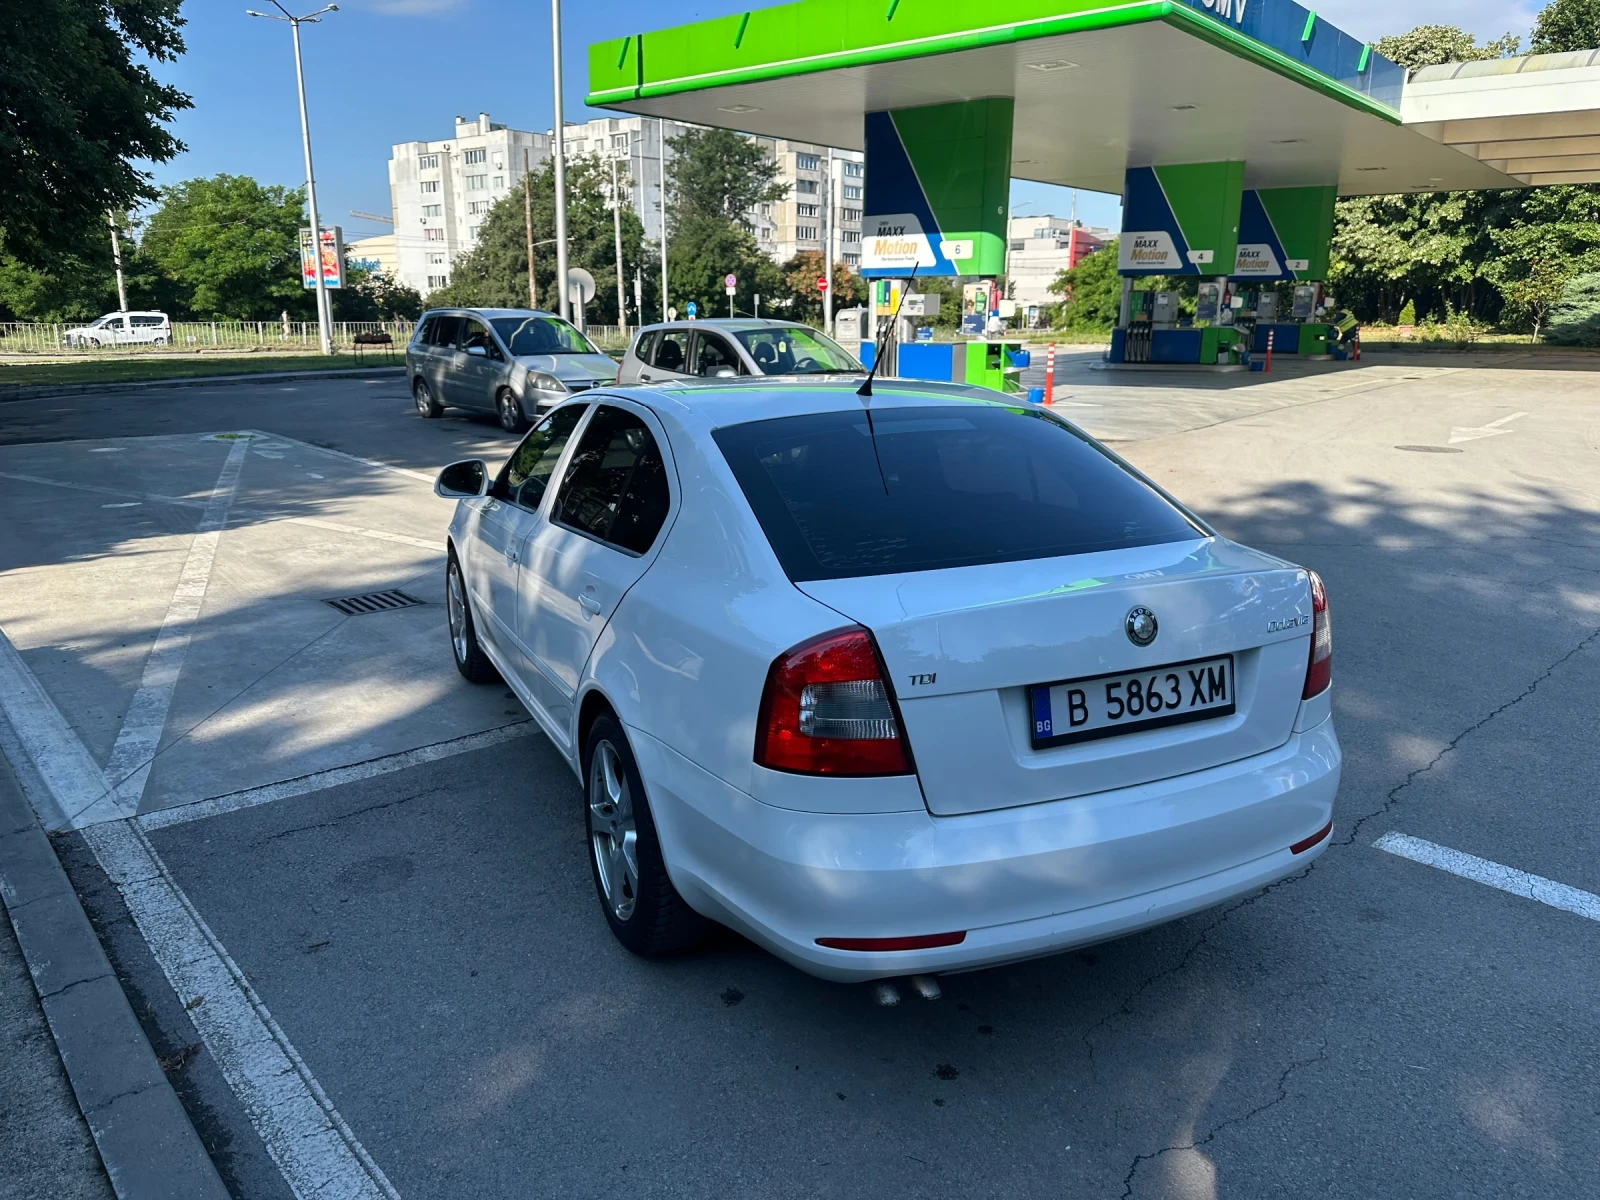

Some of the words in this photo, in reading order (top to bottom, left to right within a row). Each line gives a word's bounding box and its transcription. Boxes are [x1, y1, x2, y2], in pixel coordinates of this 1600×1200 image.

[997, 205, 1003, 215] 6
[877, 226, 906, 237] MAXX
[874, 238, 918, 256] Motion
[955, 244, 961, 255] 6
[1134, 240, 1159, 248] MAXX
[1130, 248, 1168, 261] Motion
[1236, 258, 1269, 268] Motion
[908, 672, 937, 686] TDI
[1067, 689, 1089, 727] B
[1105, 673, 1182, 720] 5863
[1187, 665, 1226, 706] XM
[1036, 719, 1051, 733] BG
